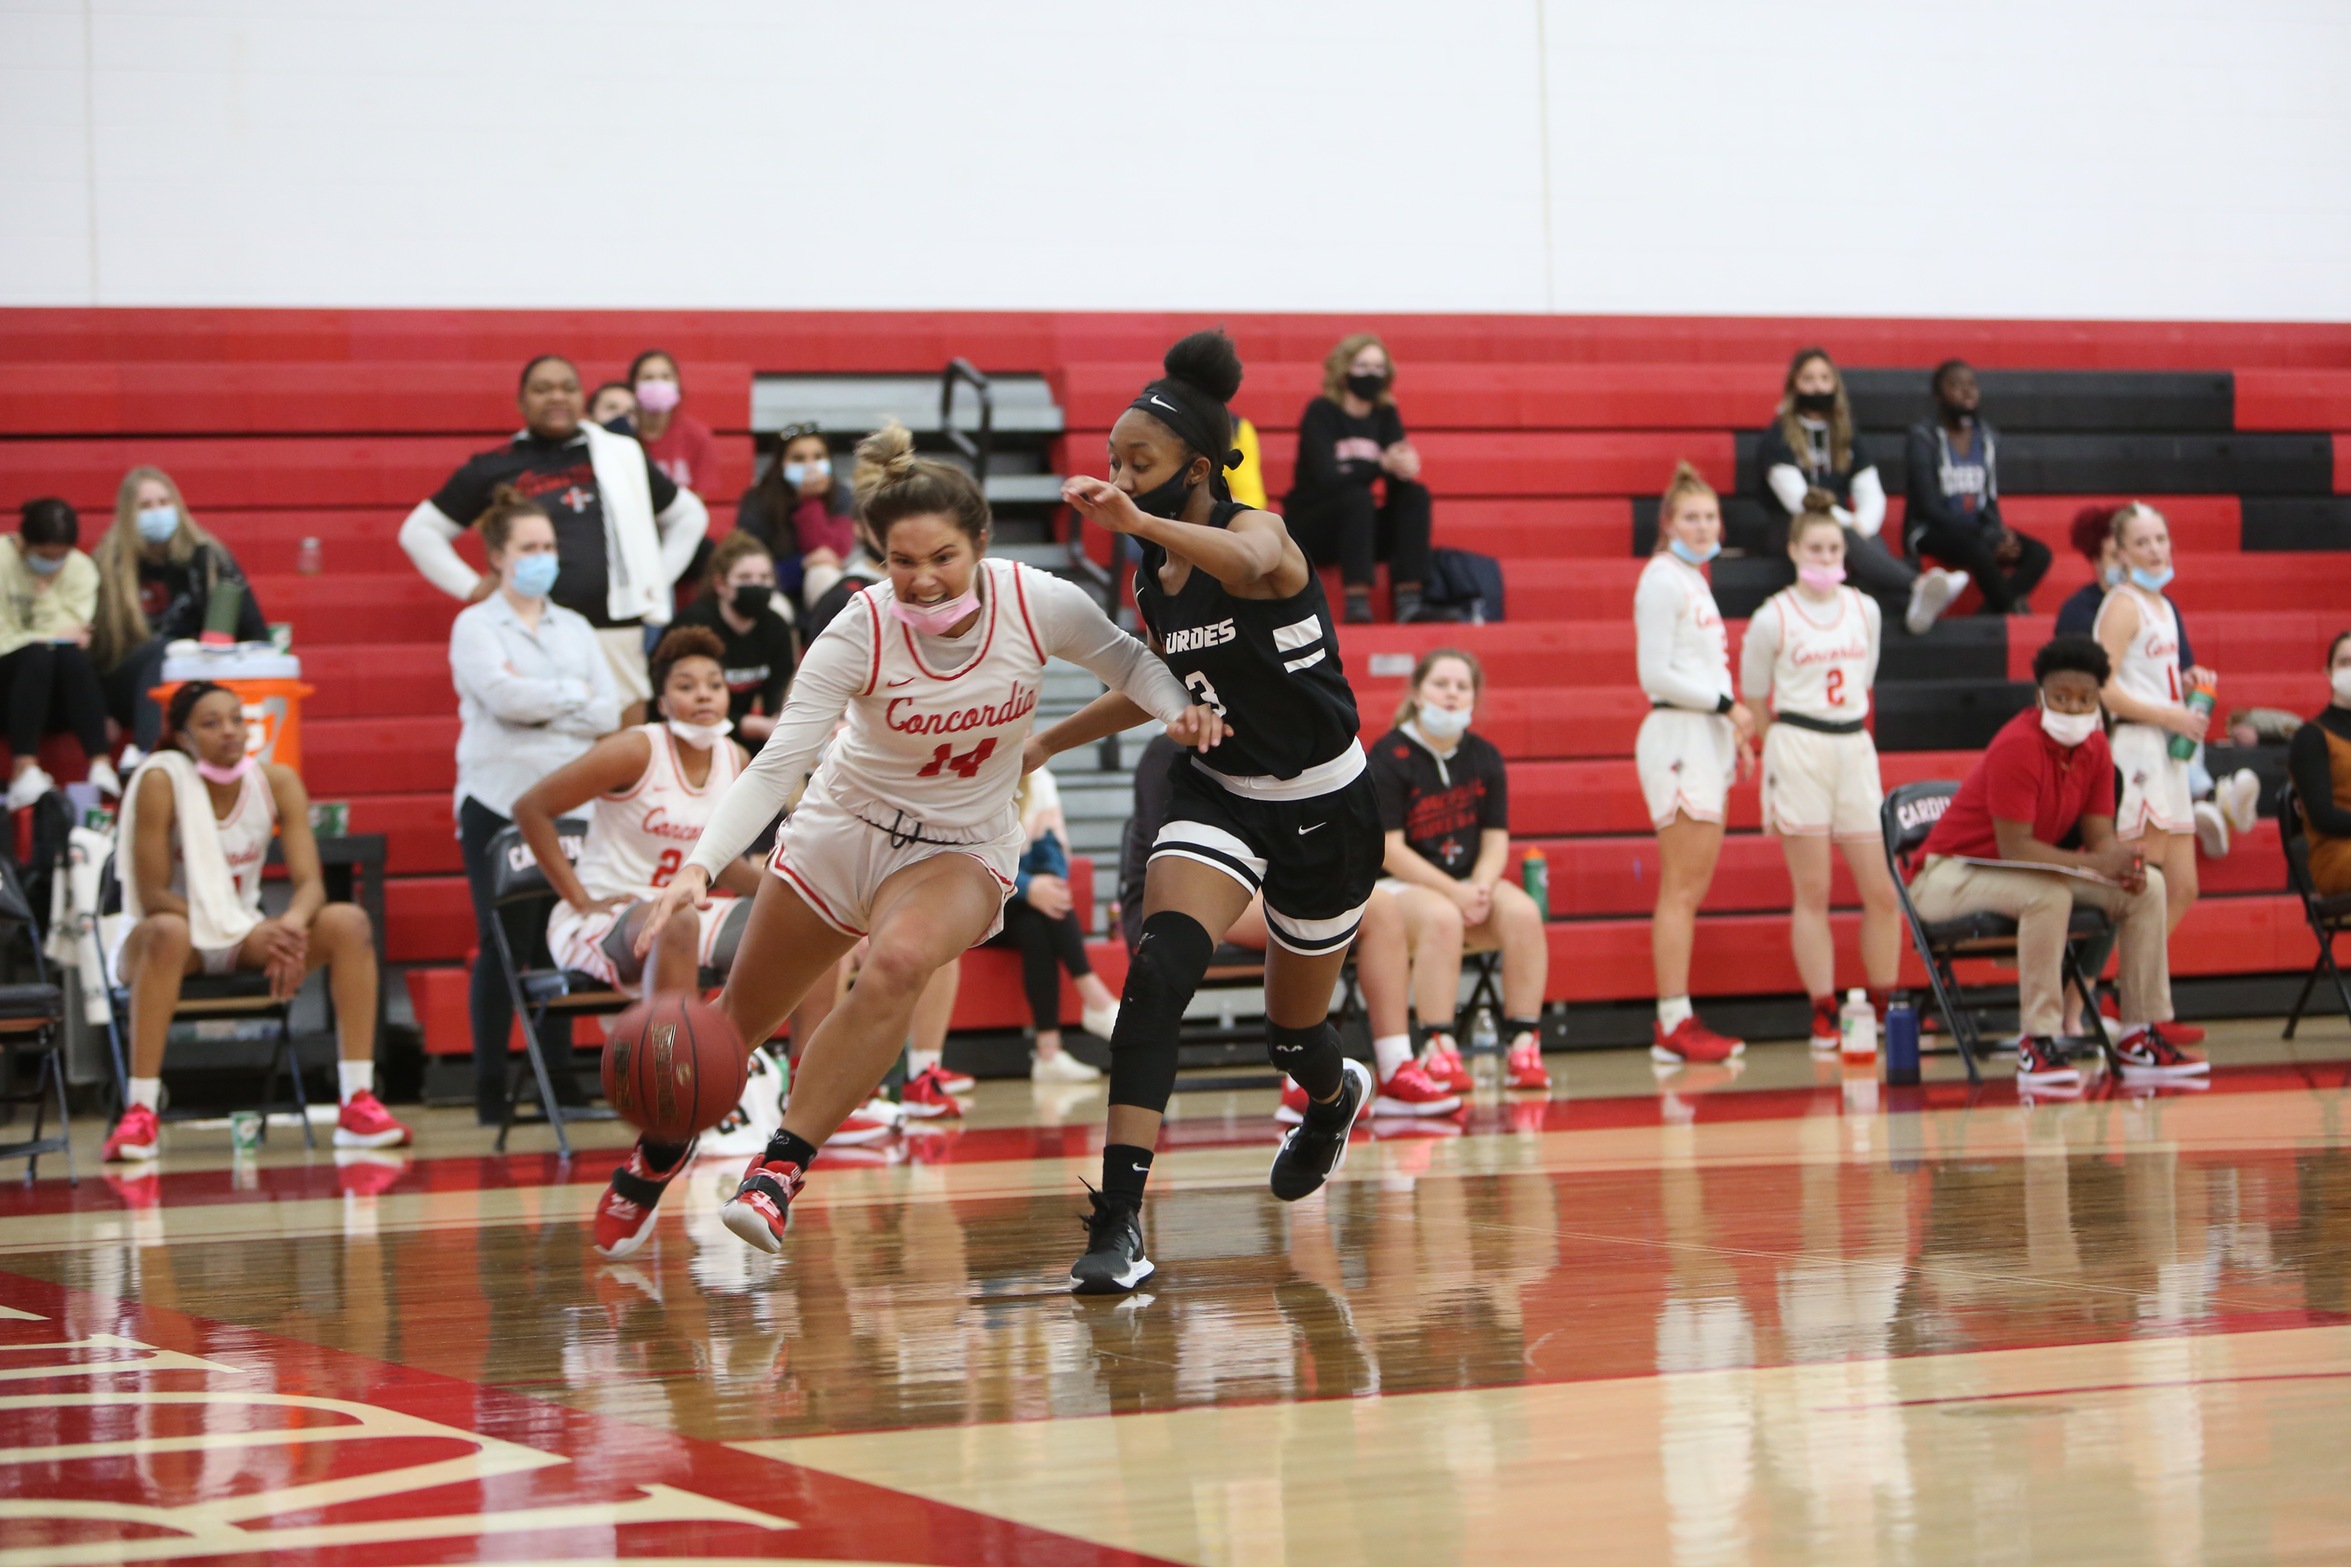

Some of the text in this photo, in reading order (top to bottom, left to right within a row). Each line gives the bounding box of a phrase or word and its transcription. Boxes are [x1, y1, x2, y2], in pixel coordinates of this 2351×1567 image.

[886, 680, 1036, 735] Concordia
[1185, 670, 1227, 718] 3
[1827, 668, 1846, 706] 2
[916, 737, 999, 778] 14
[650, 847, 682, 888] 2
